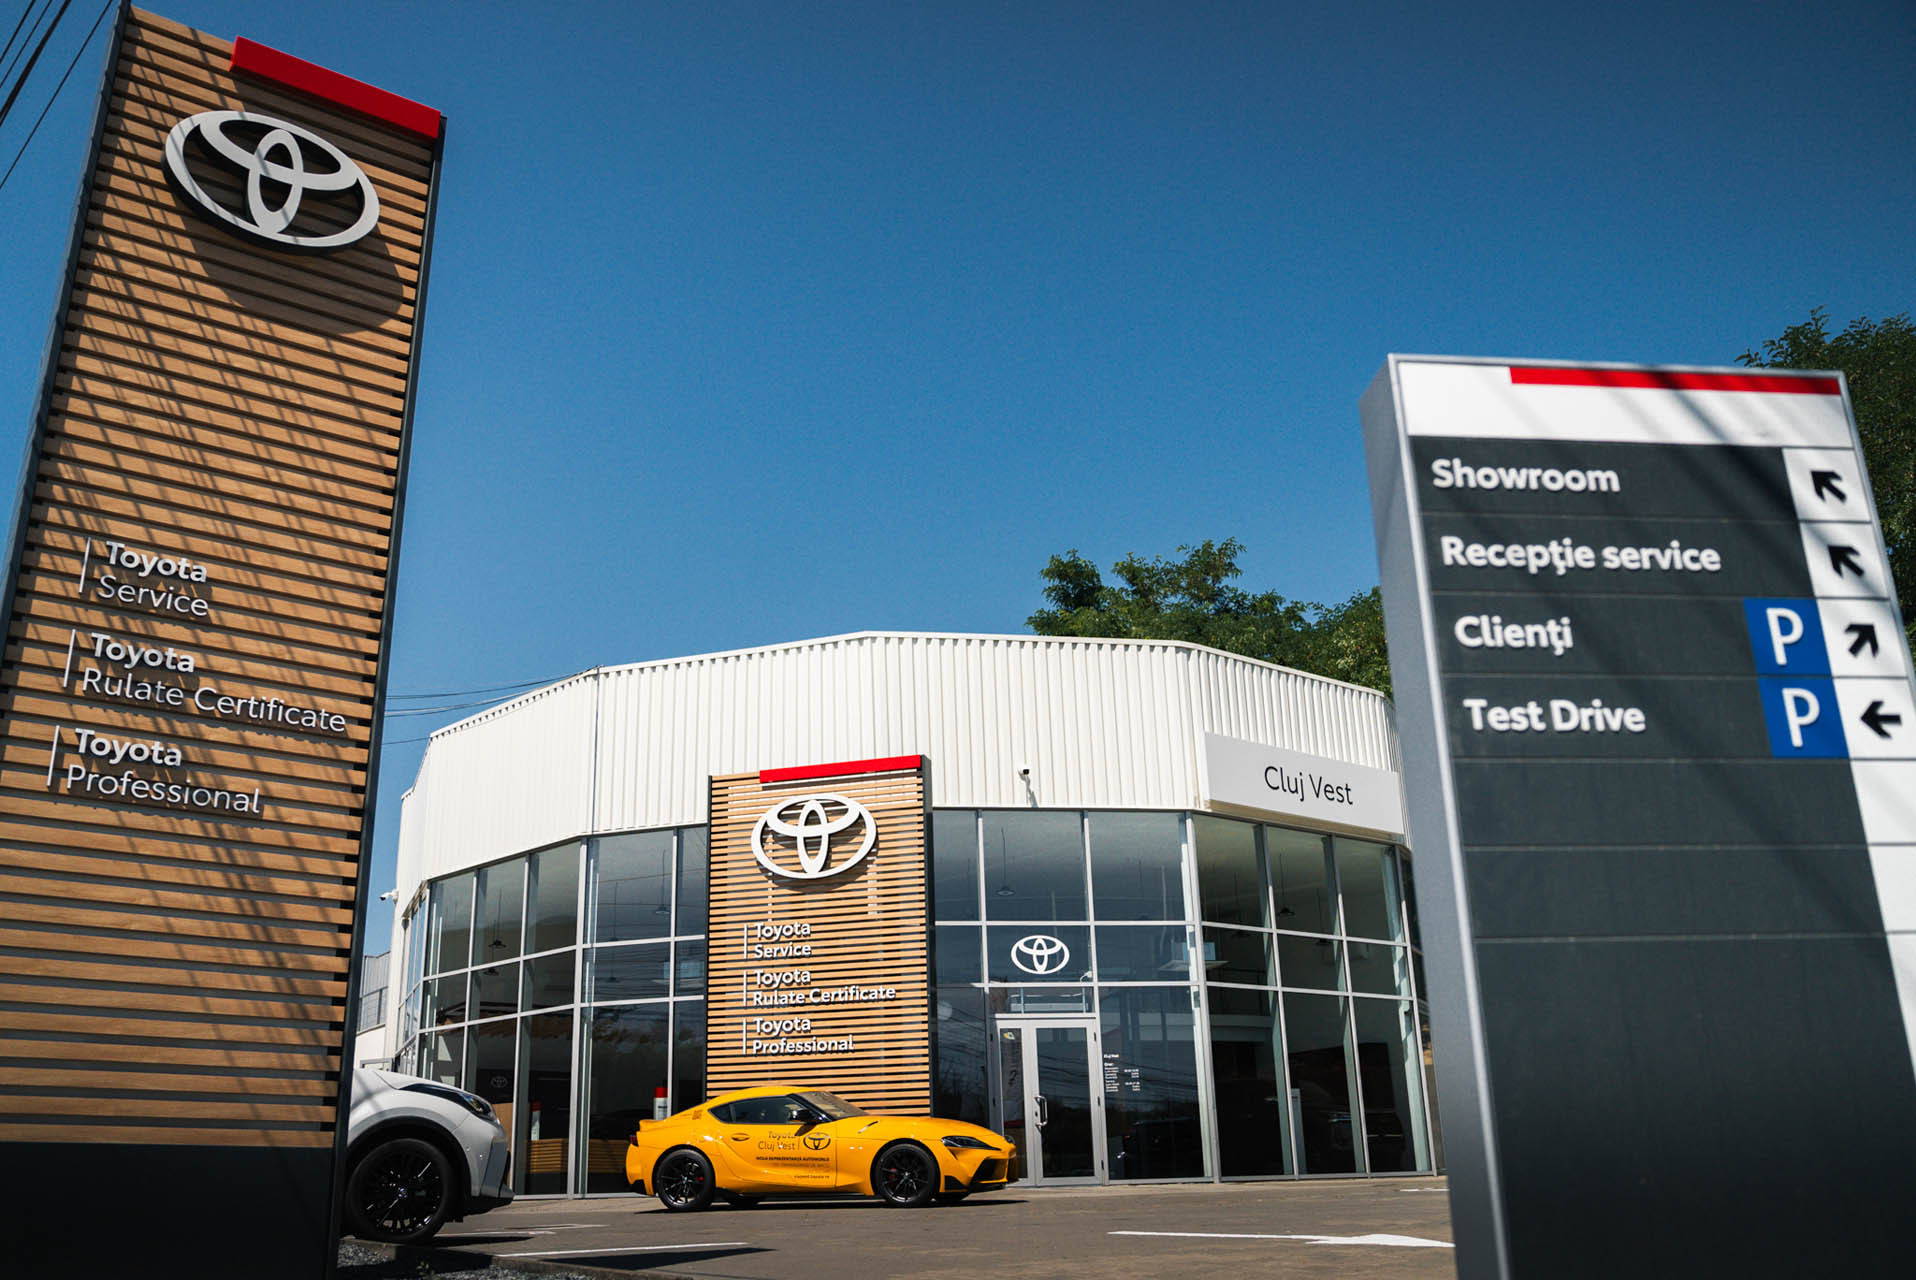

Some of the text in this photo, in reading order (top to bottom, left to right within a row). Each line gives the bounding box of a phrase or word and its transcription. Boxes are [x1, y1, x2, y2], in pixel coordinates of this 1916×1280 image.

[1431, 457, 1621, 492] Showroom
[105, 541, 208, 583] Toyota
[1601, 539, 1721, 572] service
[98, 574, 210, 617] Service
[91, 632, 196, 673] Toyota
[1765, 607, 1804, 666] P
[82, 667, 346, 732] Rulate Certificate
[1463, 698, 1647, 732] Test Drive
[1781, 687, 1820, 748] P
[75, 728, 182, 767] Toyota
[66, 765, 261, 814] Professional
[1264, 765, 1354, 805] Cluj Vest
[753, 921, 811, 941] Toyota
[753, 942, 812, 959] Service
[752, 986, 896, 1006] Rulate Certificate
[753, 968, 811, 988] Toyota
[752, 1034, 854, 1054] Professional
[753, 1016, 812, 1036] Toyota
